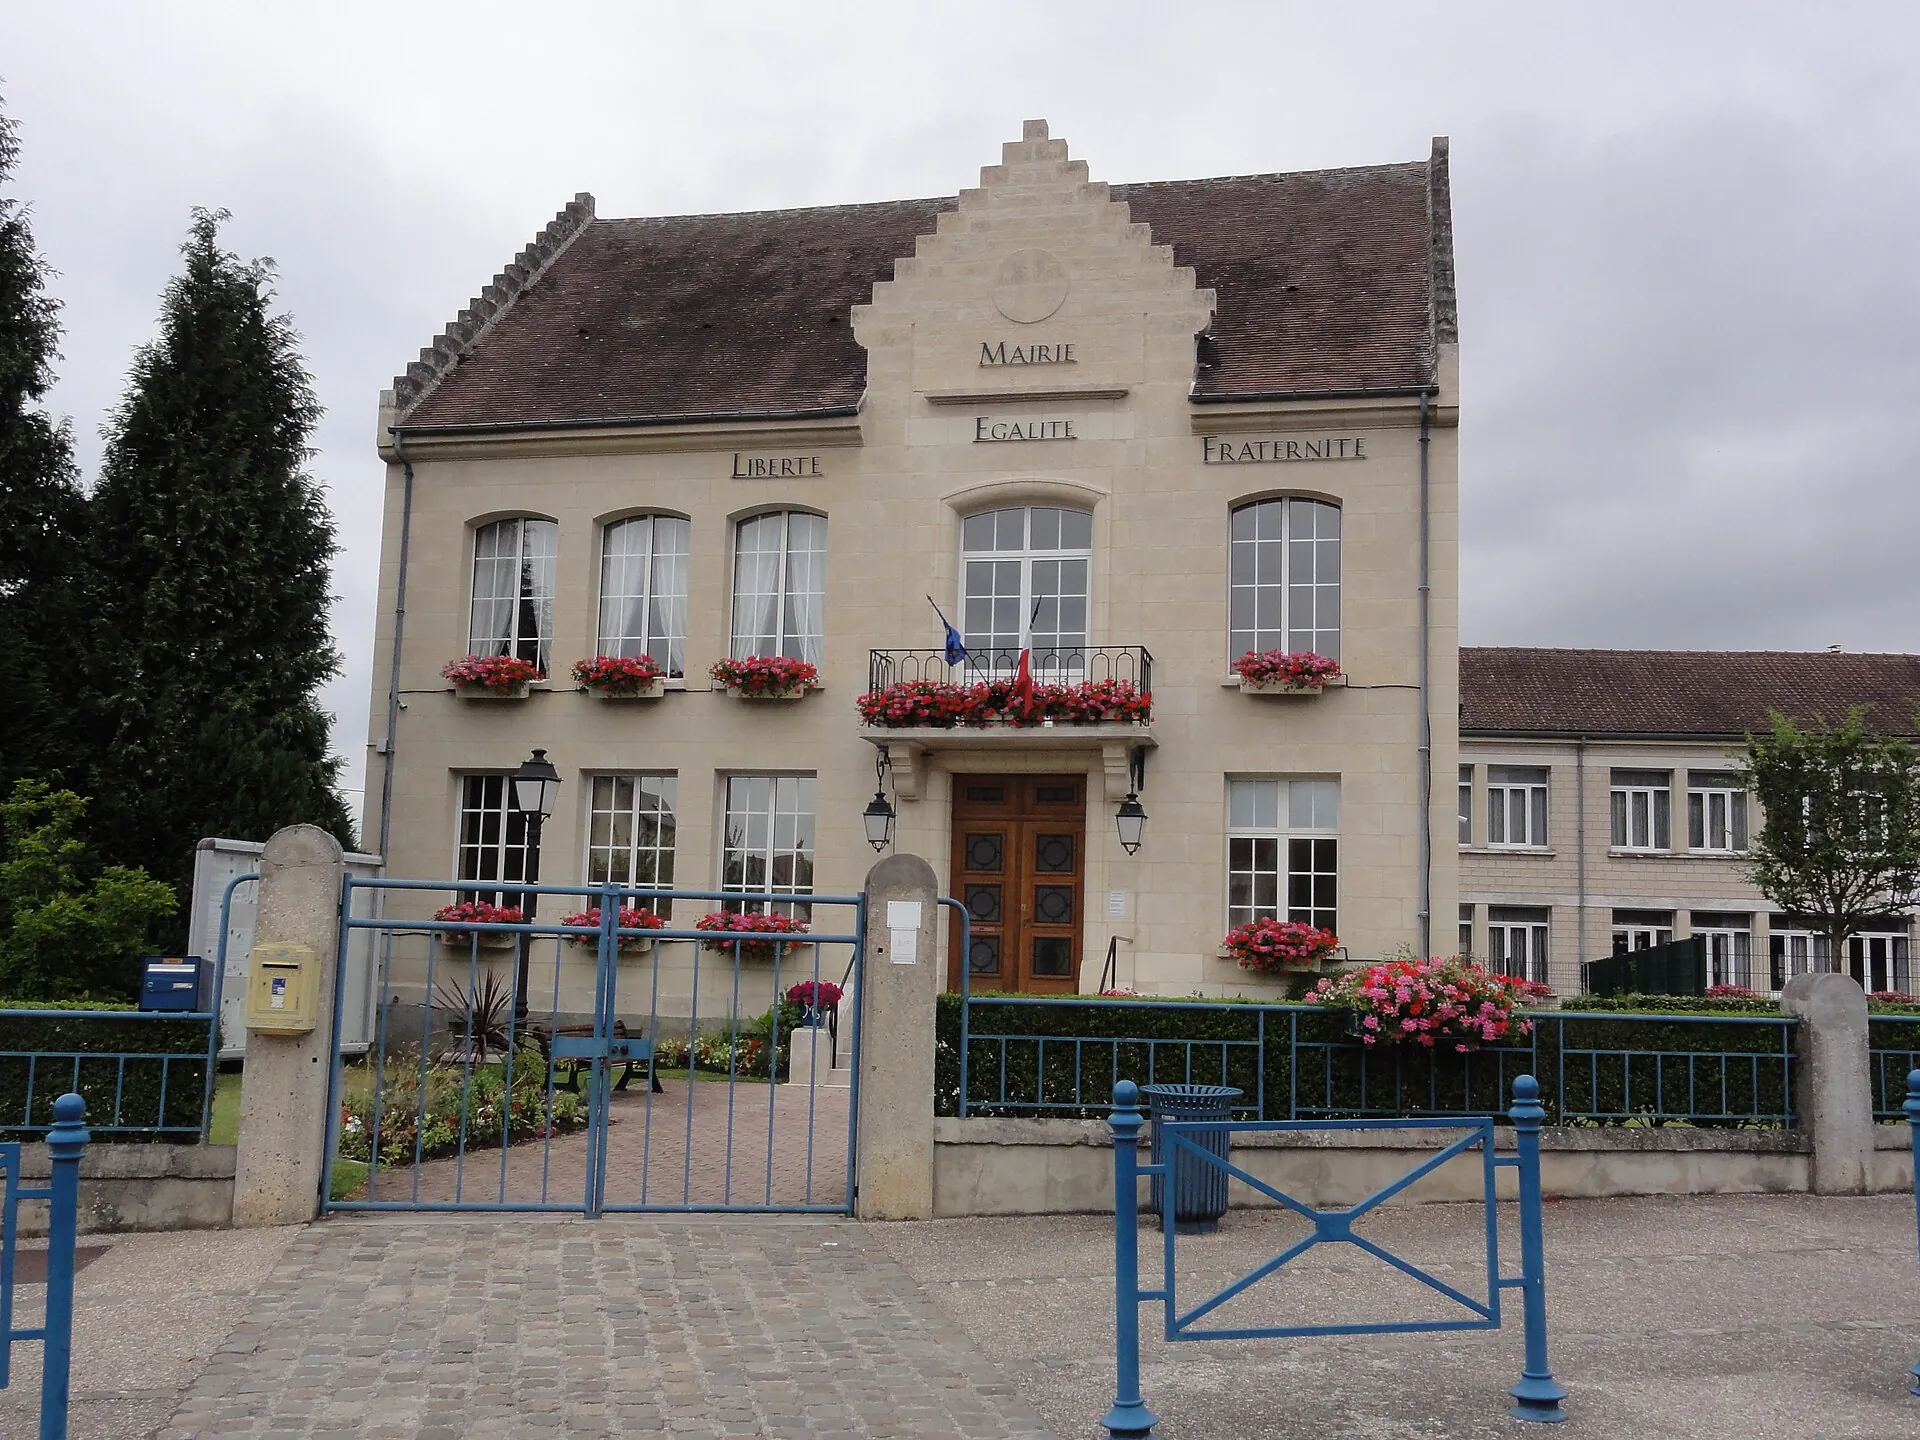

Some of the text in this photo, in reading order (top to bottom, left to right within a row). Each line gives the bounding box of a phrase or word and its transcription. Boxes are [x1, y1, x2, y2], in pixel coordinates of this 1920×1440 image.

[979, 341, 1077, 366] MAIRIE
[974, 416, 1076, 441] EGALITE
[1201, 435, 1368, 462] FRATERNITE
[732, 452, 823, 478] LIBERTE
